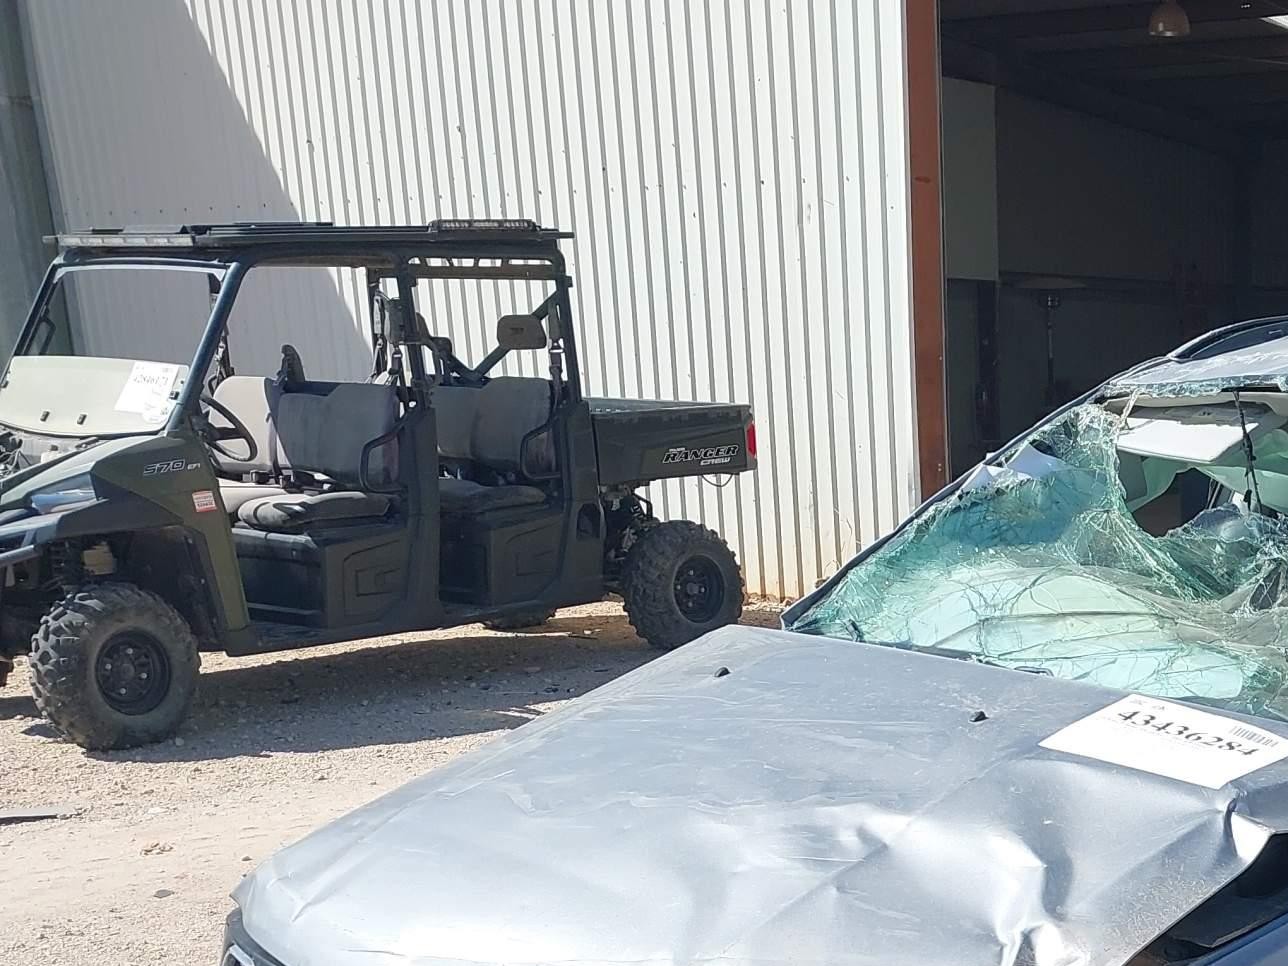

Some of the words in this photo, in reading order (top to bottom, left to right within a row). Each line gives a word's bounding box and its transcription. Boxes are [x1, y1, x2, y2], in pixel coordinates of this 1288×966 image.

[663, 445, 738, 463] RANGER
[700, 457, 731, 466] CREW
[144, 459, 185, 476] 570
[1118, 710, 1259, 756] 43436284
